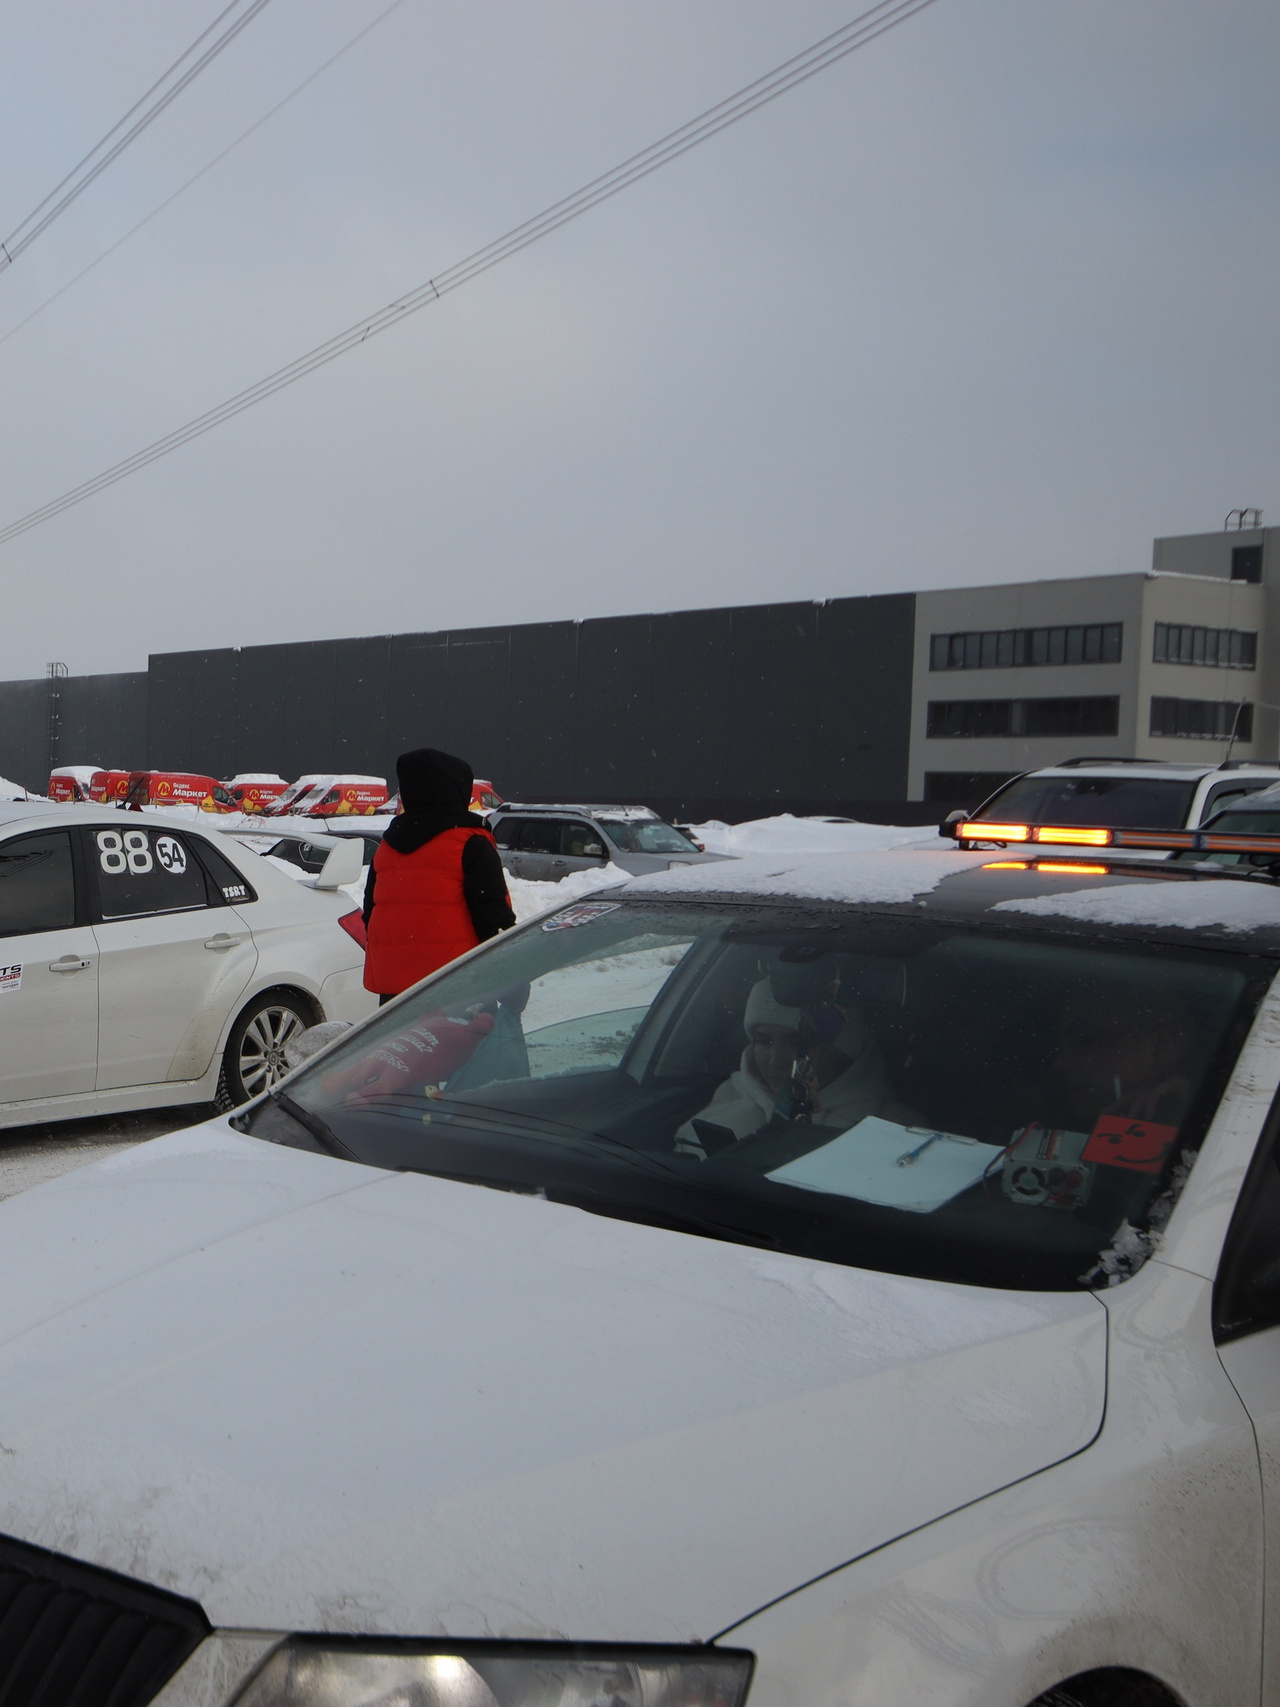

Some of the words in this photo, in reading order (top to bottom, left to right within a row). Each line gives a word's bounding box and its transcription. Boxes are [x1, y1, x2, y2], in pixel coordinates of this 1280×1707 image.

[173, 789, 207, 797] Маркет
[96, 830, 153, 874] 88
[157, 843, 184, 869] 54
[222, 885, 246, 898] TSRT
